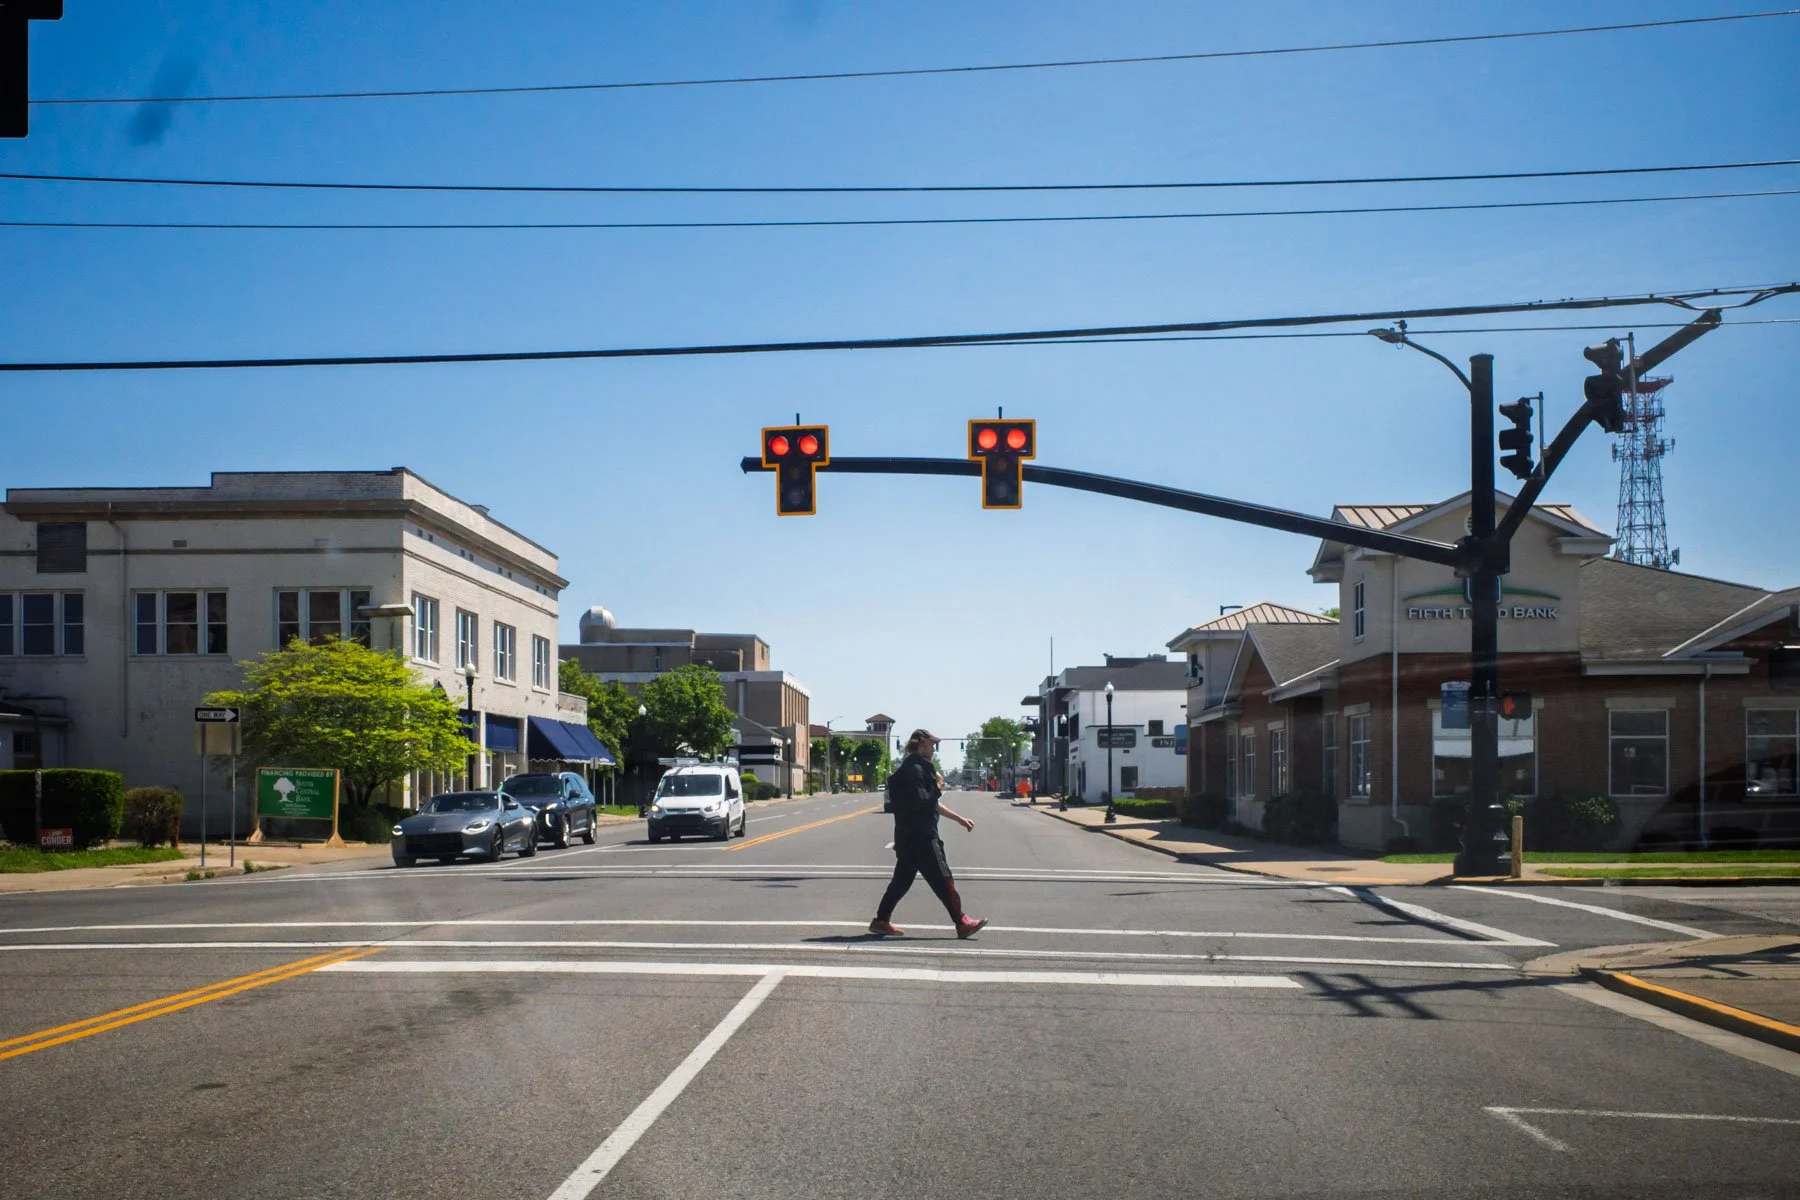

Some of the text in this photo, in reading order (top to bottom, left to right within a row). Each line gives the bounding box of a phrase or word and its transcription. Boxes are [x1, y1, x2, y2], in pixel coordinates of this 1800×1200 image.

[1407, 607, 1453, 619] FIFTH
[1512, 606, 1558, 619] BANK
[41, 836, 72, 845] CONDER
